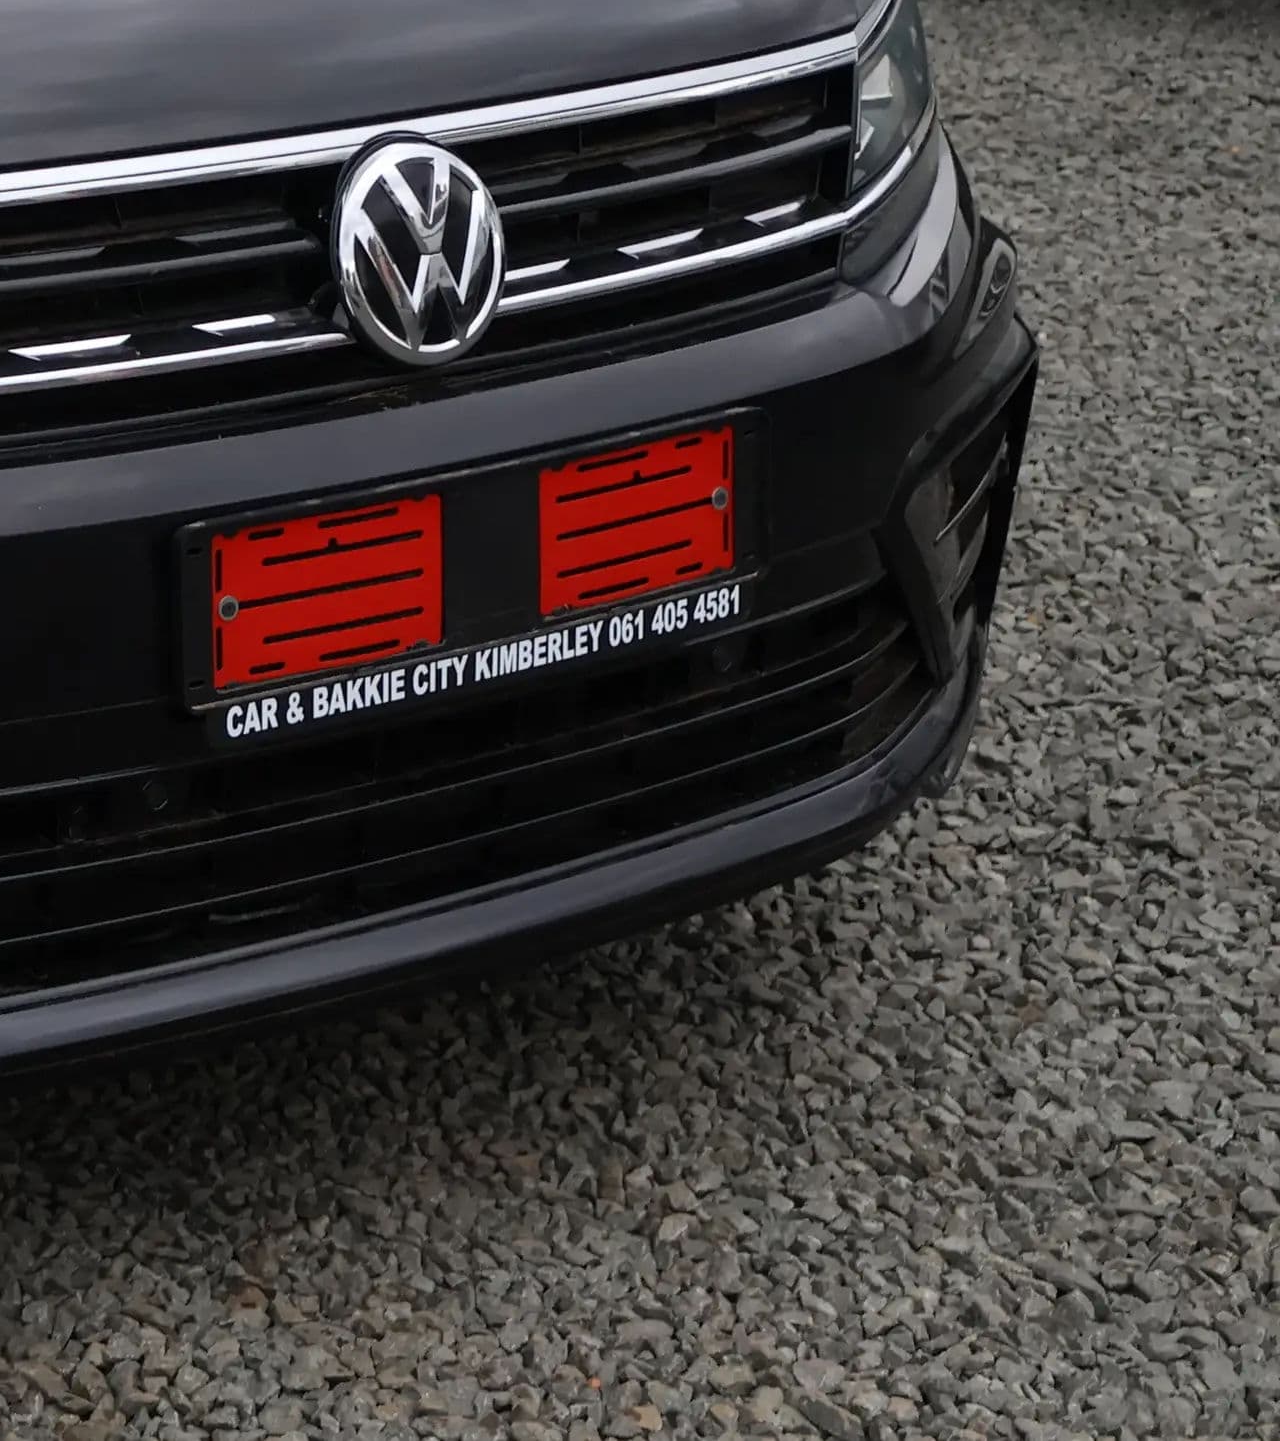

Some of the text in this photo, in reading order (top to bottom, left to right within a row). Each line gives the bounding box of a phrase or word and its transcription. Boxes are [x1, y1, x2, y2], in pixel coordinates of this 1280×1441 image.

[225, 584, 741, 739] CAR & BAKKIE CITY KIMBERLEY 061 405 4581
